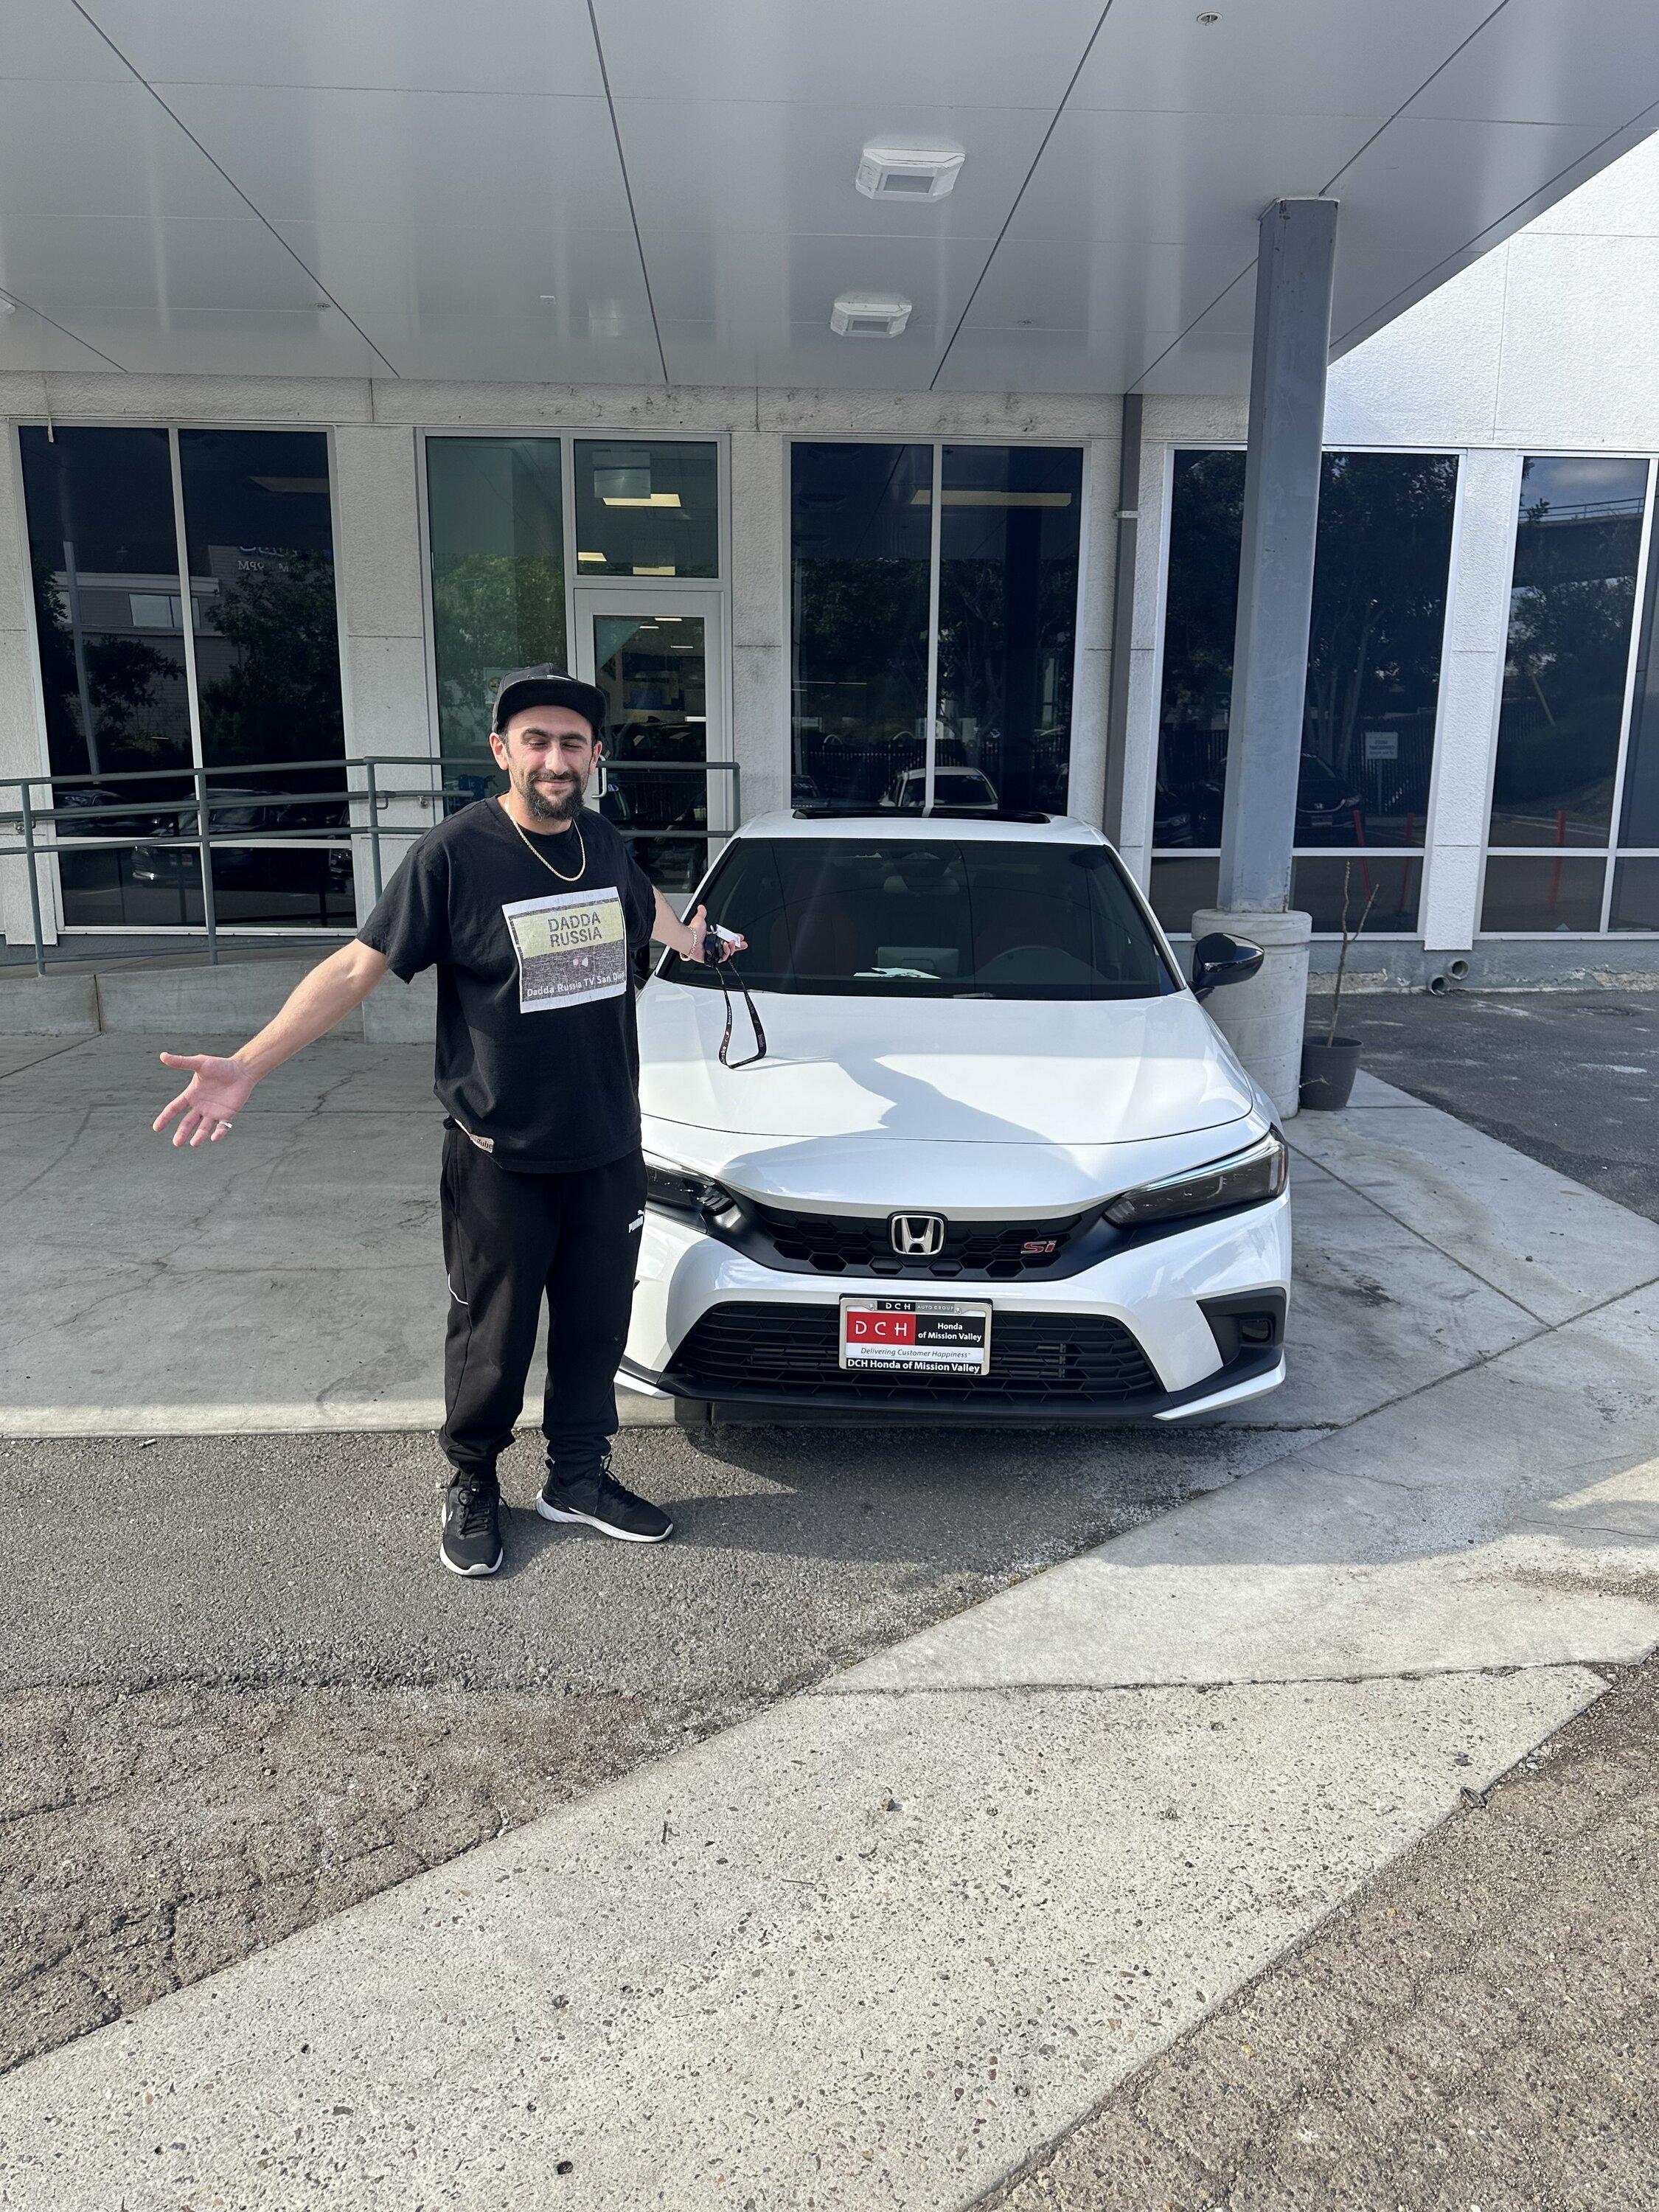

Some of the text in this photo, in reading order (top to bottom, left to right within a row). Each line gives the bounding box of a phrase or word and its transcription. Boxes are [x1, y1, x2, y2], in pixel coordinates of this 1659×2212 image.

[548, 911, 601, 933] DADDA
[550, 927, 602, 948] RUSSIA
[526, 985, 554, 997] Dadda
[557, 984, 582, 992] Russia
[583, 977, 594, 987] TV
[597, 975, 611, 984] San
[1020, 1240, 1057, 1253] Si
[886, 1302, 911, 1310] DCH
[855, 1321, 907, 1337] DCH
[937, 1322, 963, 1330] Honda
[959, 1332, 982, 1342] Valley
[860, 1347, 896, 1357] Delivering
[897, 1349, 931, 1357] Customer
[847, 1359, 981, 1374] DCH Honda of Mission Valley
